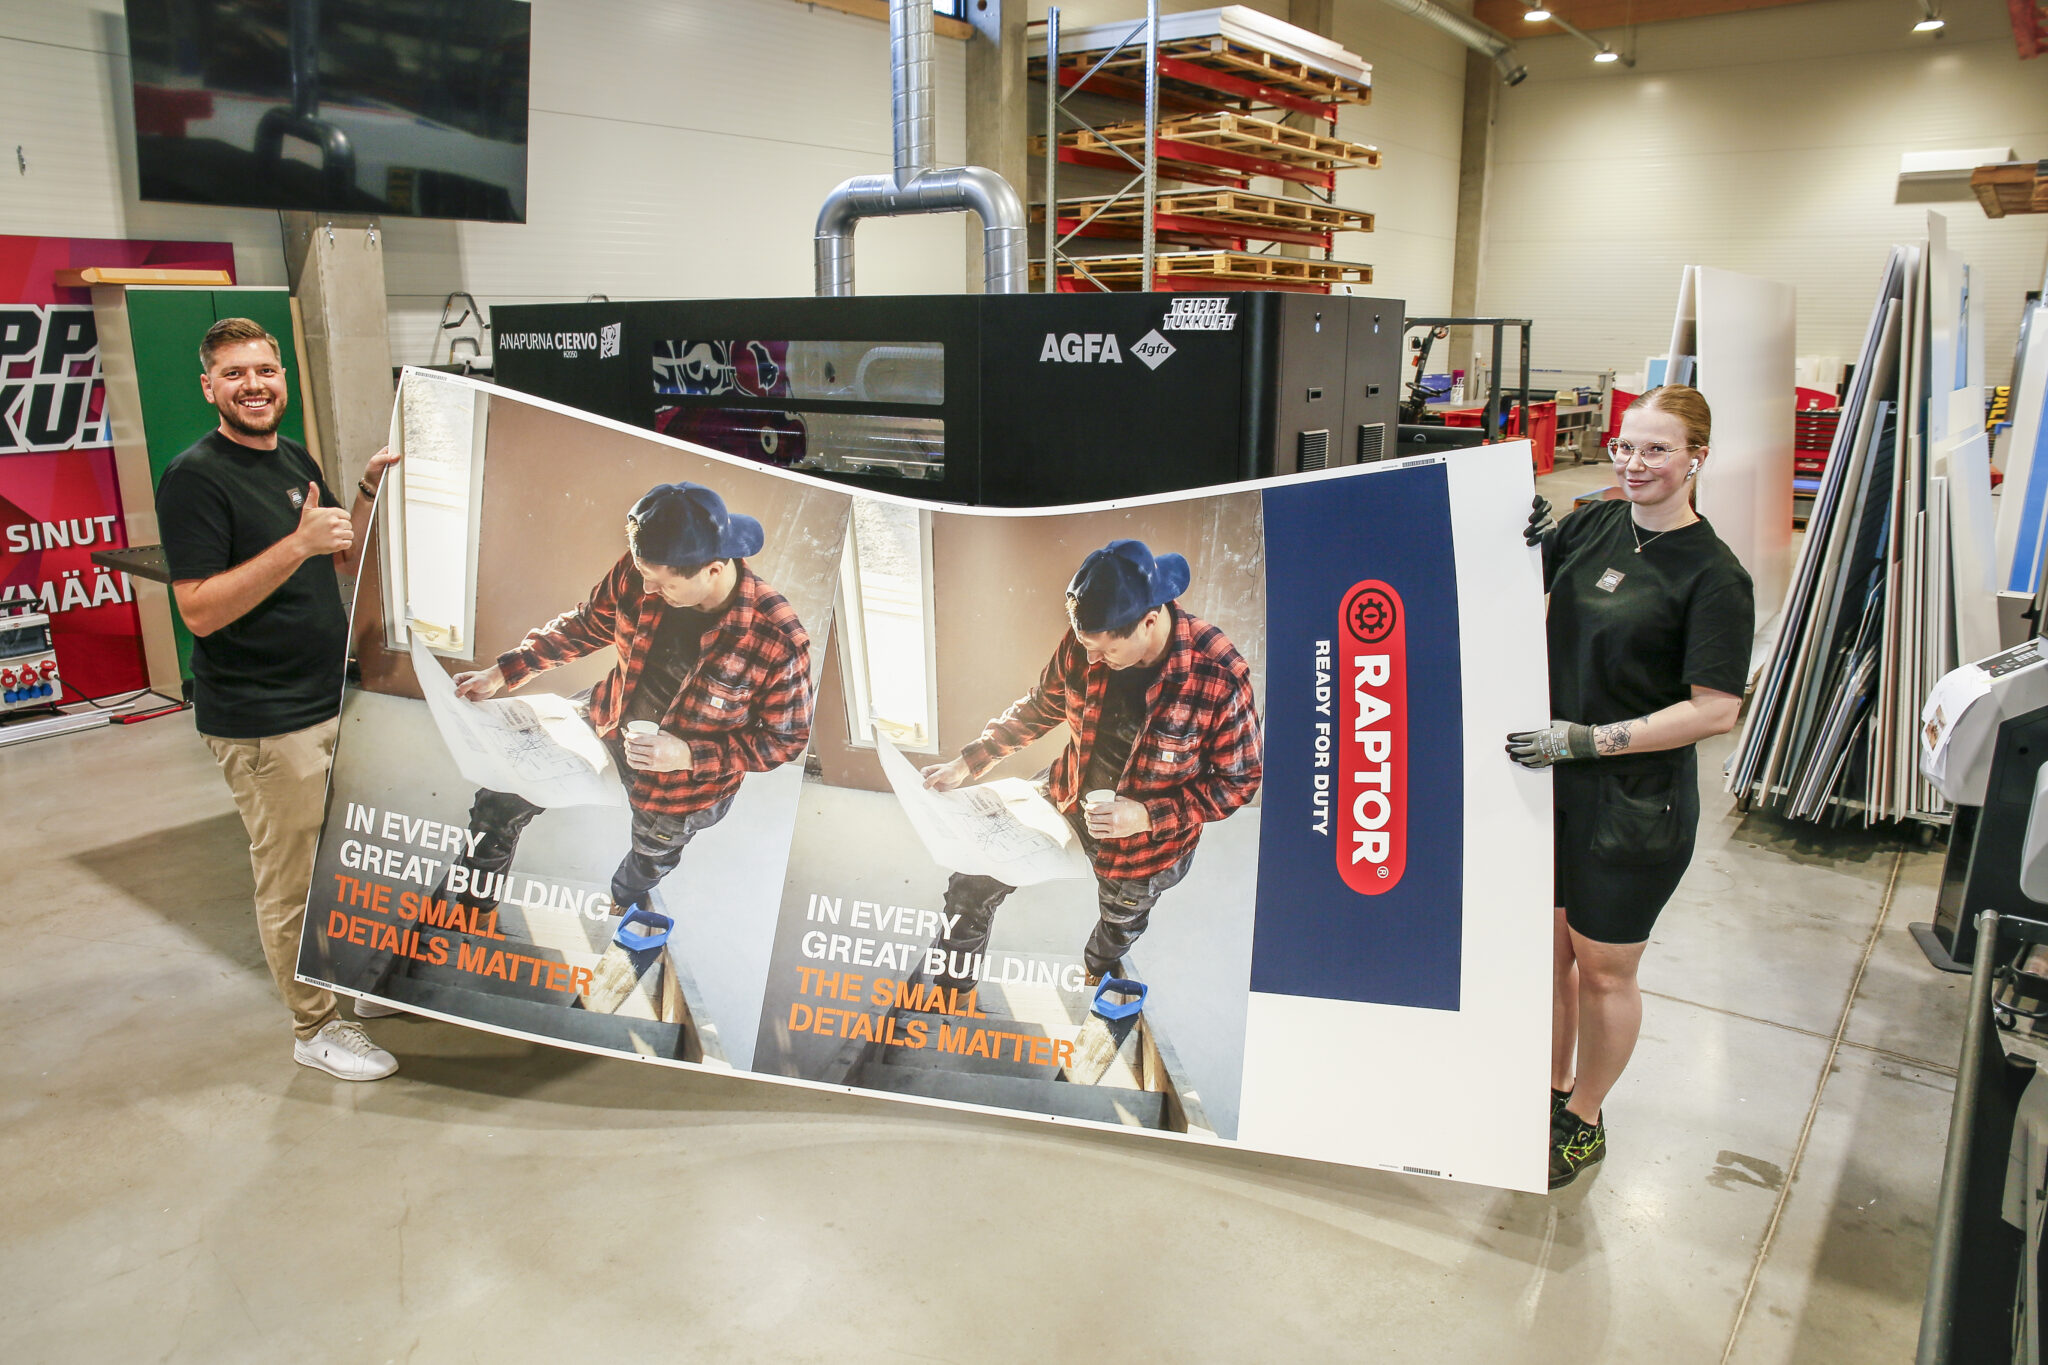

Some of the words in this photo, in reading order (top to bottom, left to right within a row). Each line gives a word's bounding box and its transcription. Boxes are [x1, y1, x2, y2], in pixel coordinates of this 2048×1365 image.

[1171, 298, 1230, 314] TEIPPI
[0, 304, 103, 378] PP
[499, 333, 554, 350] ANAPURNA
[554, 332, 598, 350] CIERVO
[1039, 333, 1123, 364] AGFA
[1136, 342, 1170, 358] Agfa
[6, 515, 116, 553] SINUT
[1315, 640, 1331, 716] READY
[1314, 723, 1331, 768] FOR
[345, 802, 376, 835] IN
[381, 811, 487, 858] EVERY
[1312, 775, 1330, 836] DUTY
[334, 874, 394, 914] THE
[397, 891, 506, 941] SMALL
[340, 839, 442, 887] GREAT
[446, 864, 612, 922] BUILDING
[806, 893, 843, 925] IN
[850, 901, 962, 941] EVERY
[327, 910, 449, 966] DETAILS
[456, 941, 594, 997] MATTER
[801, 931, 917, 971] GREAT
[924, 948, 1086, 994] BUILDING
[797, 966, 864, 1002] THE
[871, 978, 987, 1020] SMALL
[788, 1003, 929, 1049] DETAILS
[937, 1024, 1076, 1069] MATTER
